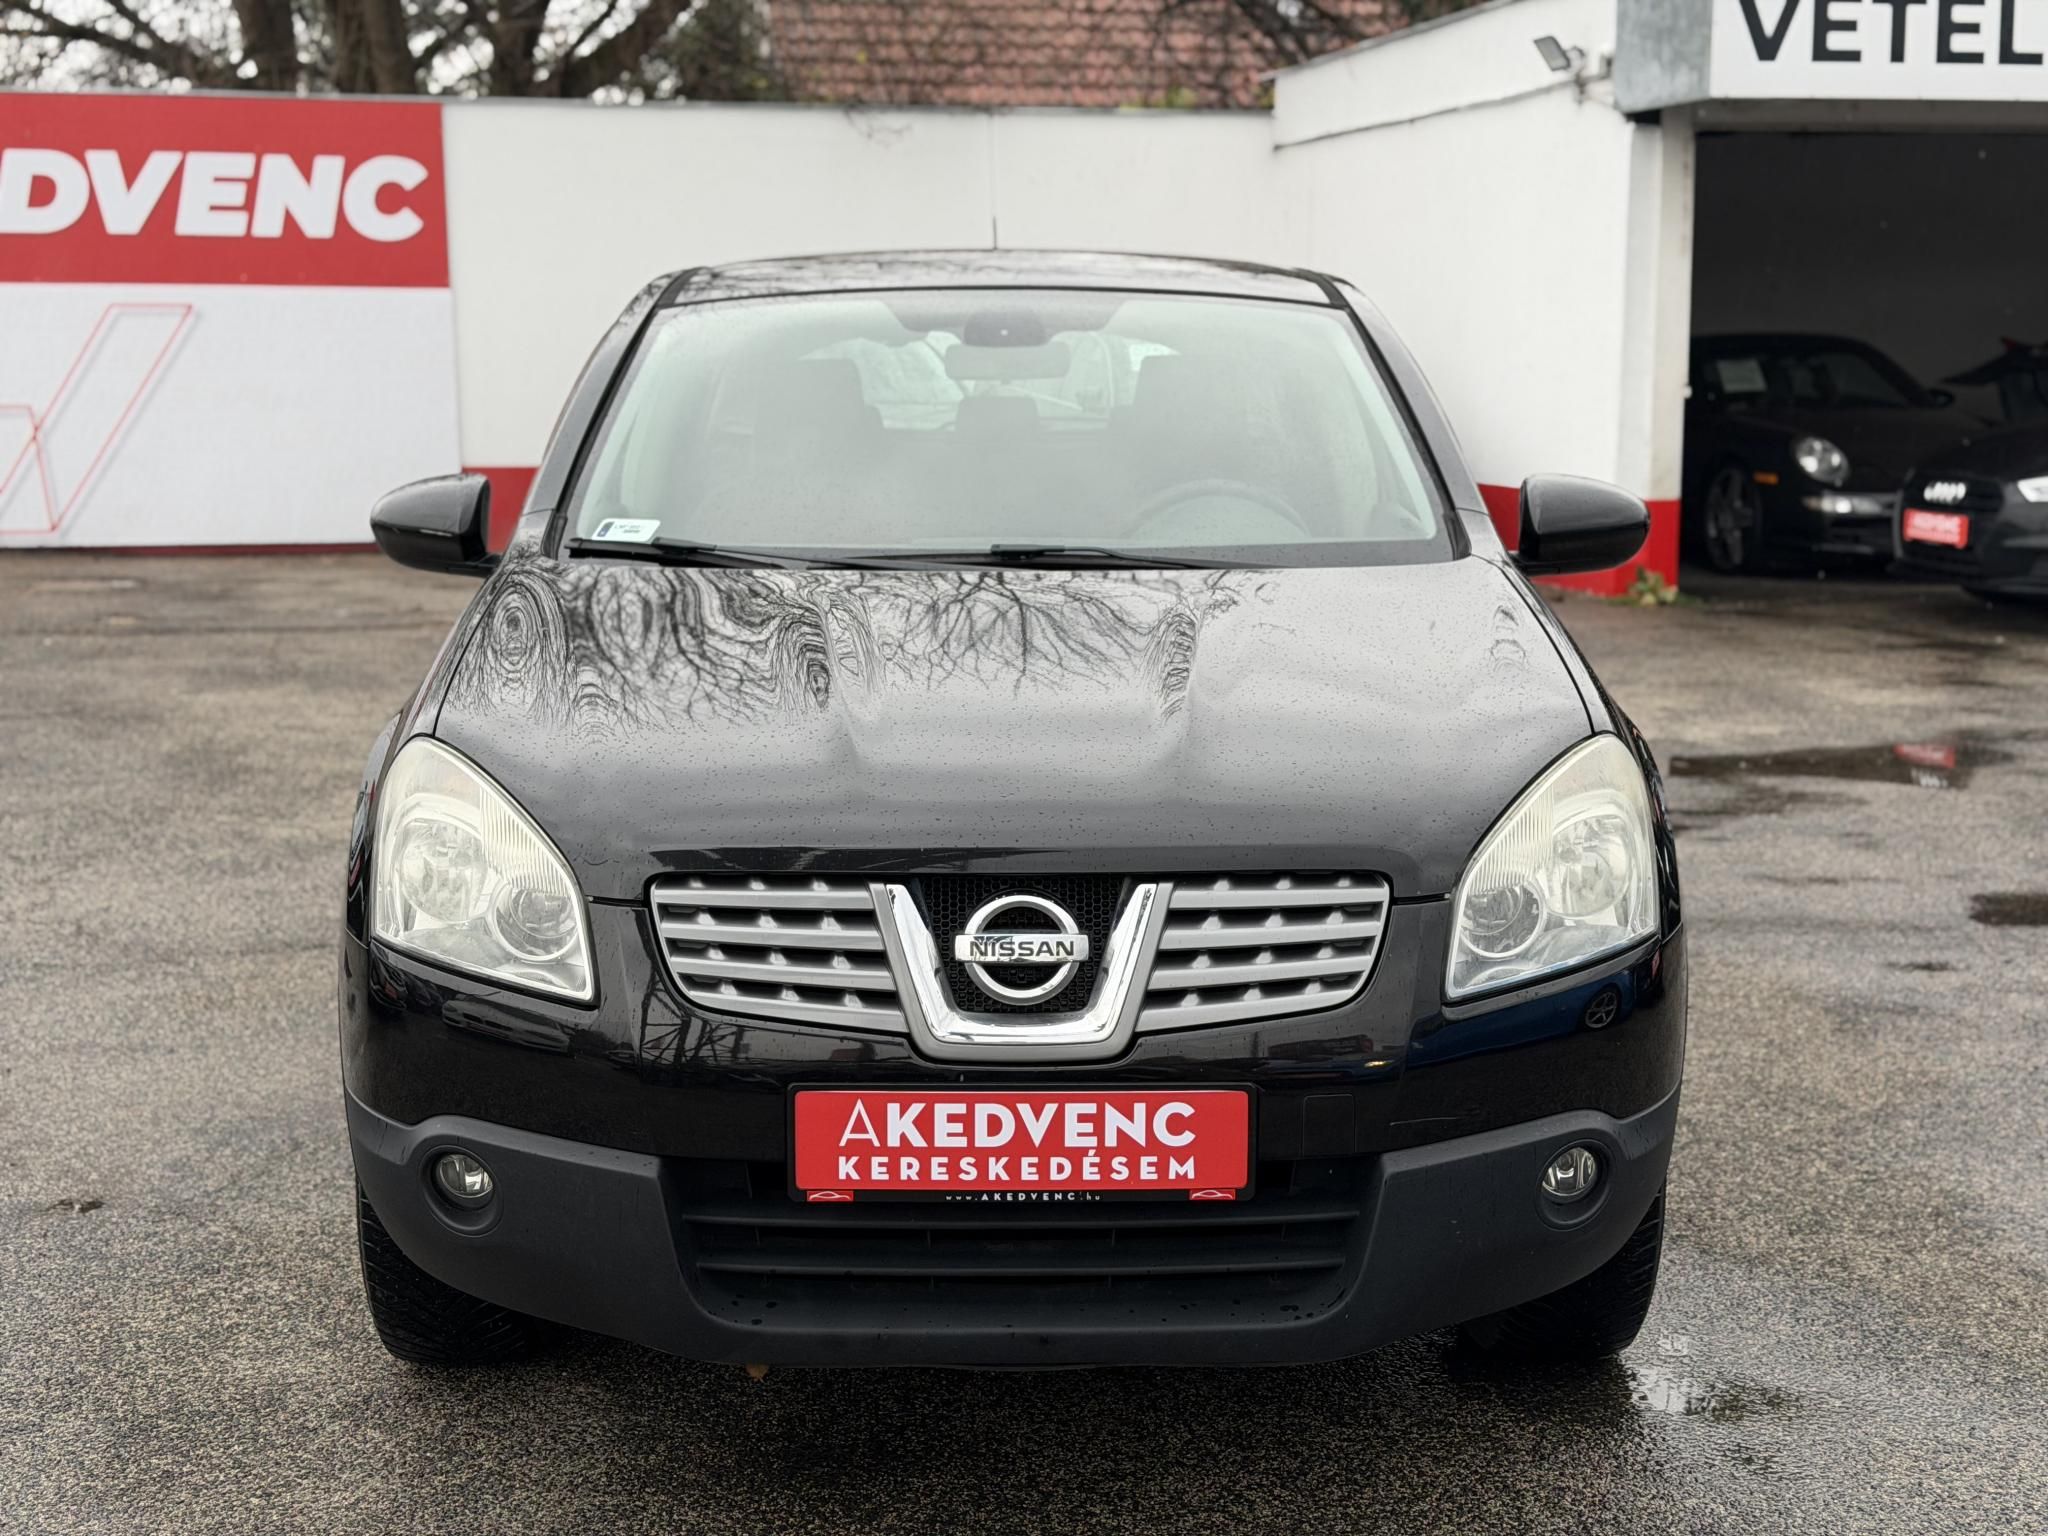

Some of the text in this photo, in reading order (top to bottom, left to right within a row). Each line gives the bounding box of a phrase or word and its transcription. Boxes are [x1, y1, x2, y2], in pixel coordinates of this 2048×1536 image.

[1737, 0, 2044, 65] VETEL
[0, 147, 429, 242] DVENC
[969, 939, 1075, 957] NISSAN
[838, 1098, 1197, 1148] AKEDVENC
[838, 1150, 1196, 1181] KERESKEDÉSEM
